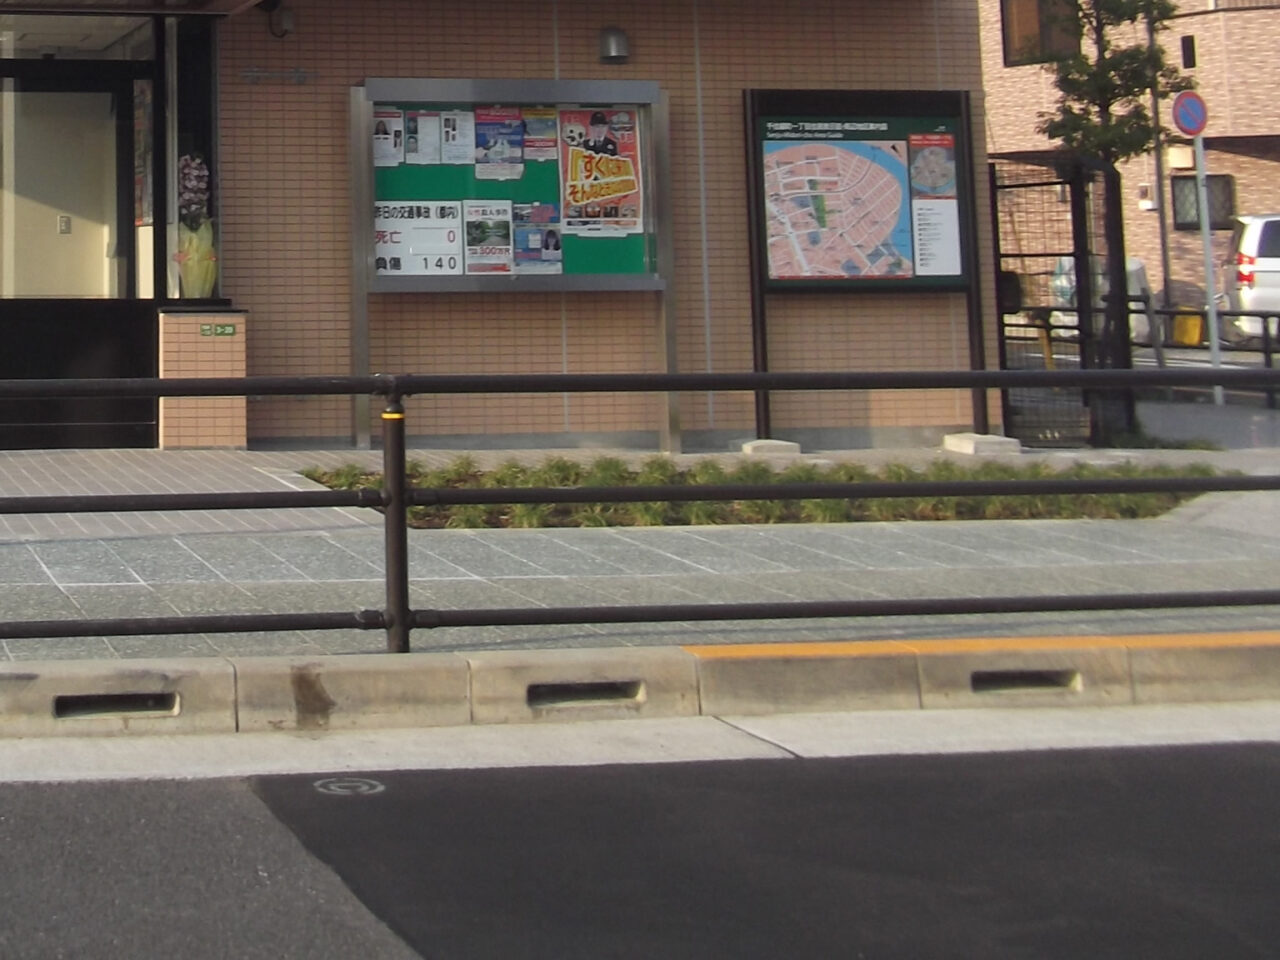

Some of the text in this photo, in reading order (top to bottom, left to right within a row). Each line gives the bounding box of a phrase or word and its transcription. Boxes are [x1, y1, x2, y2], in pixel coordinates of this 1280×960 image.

[375, 230, 456, 244] 死亡 0
[375, 256, 402, 270] 負傷
[423, 256, 457, 270] 140
